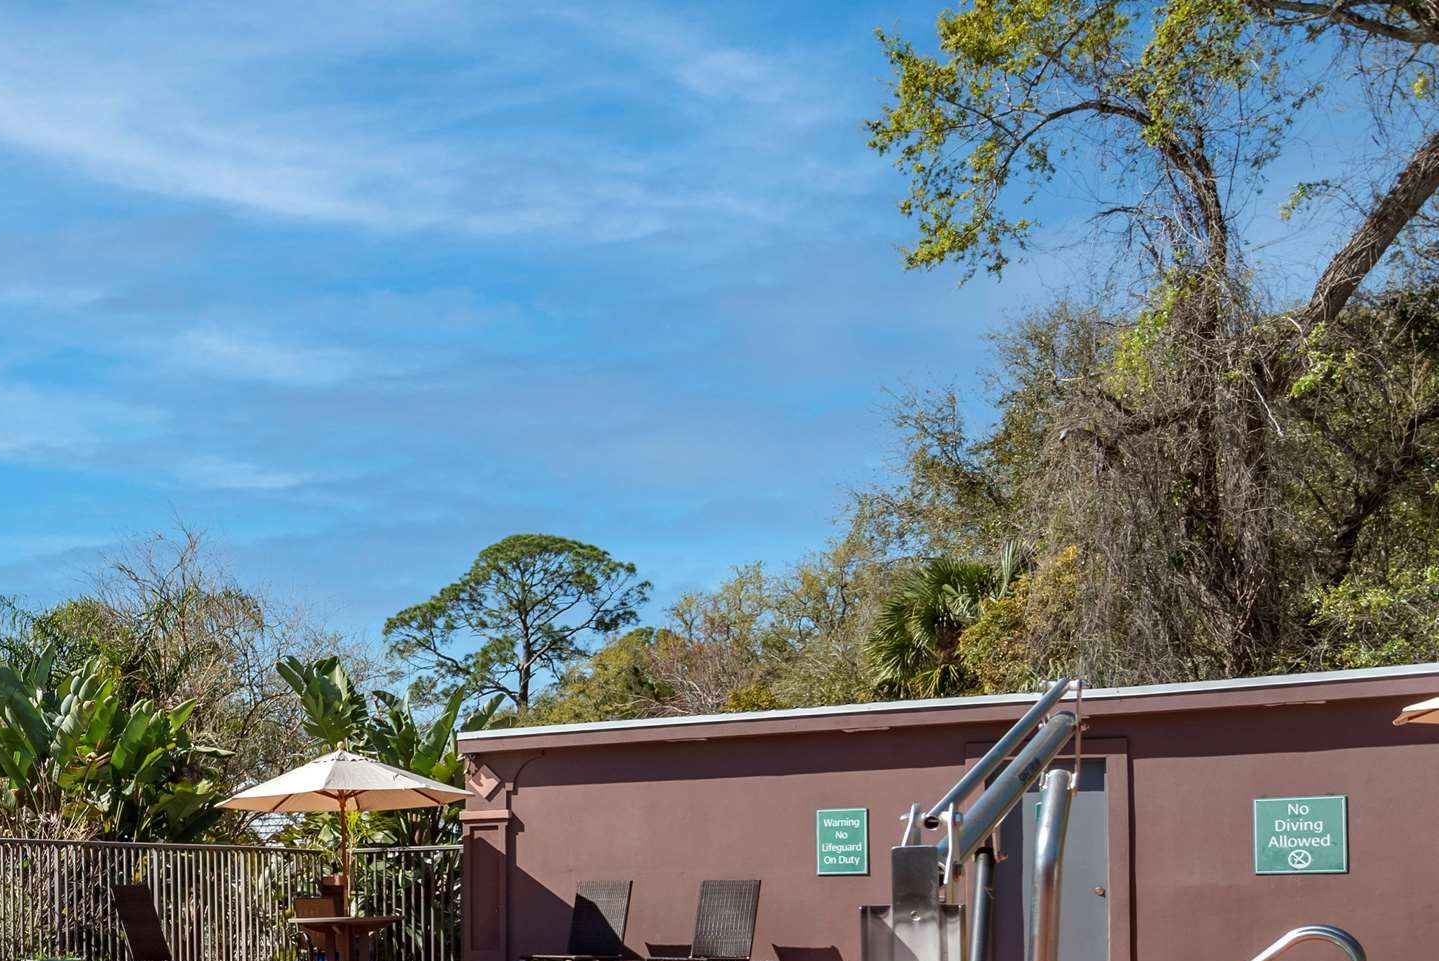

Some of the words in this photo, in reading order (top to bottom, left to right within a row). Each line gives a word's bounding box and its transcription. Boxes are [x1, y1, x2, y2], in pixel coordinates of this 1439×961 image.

[1287, 804, 1310, 815] No
[823, 818, 860, 828] Warning
[1274, 818, 1324, 833] Diving
[834, 831, 848, 839] No
[1268, 833, 1331, 848] Allowed
[821, 842, 862, 853] Lifeguard
[823, 856, 837, 864] On
[838, 855, 860, 866] Duty
